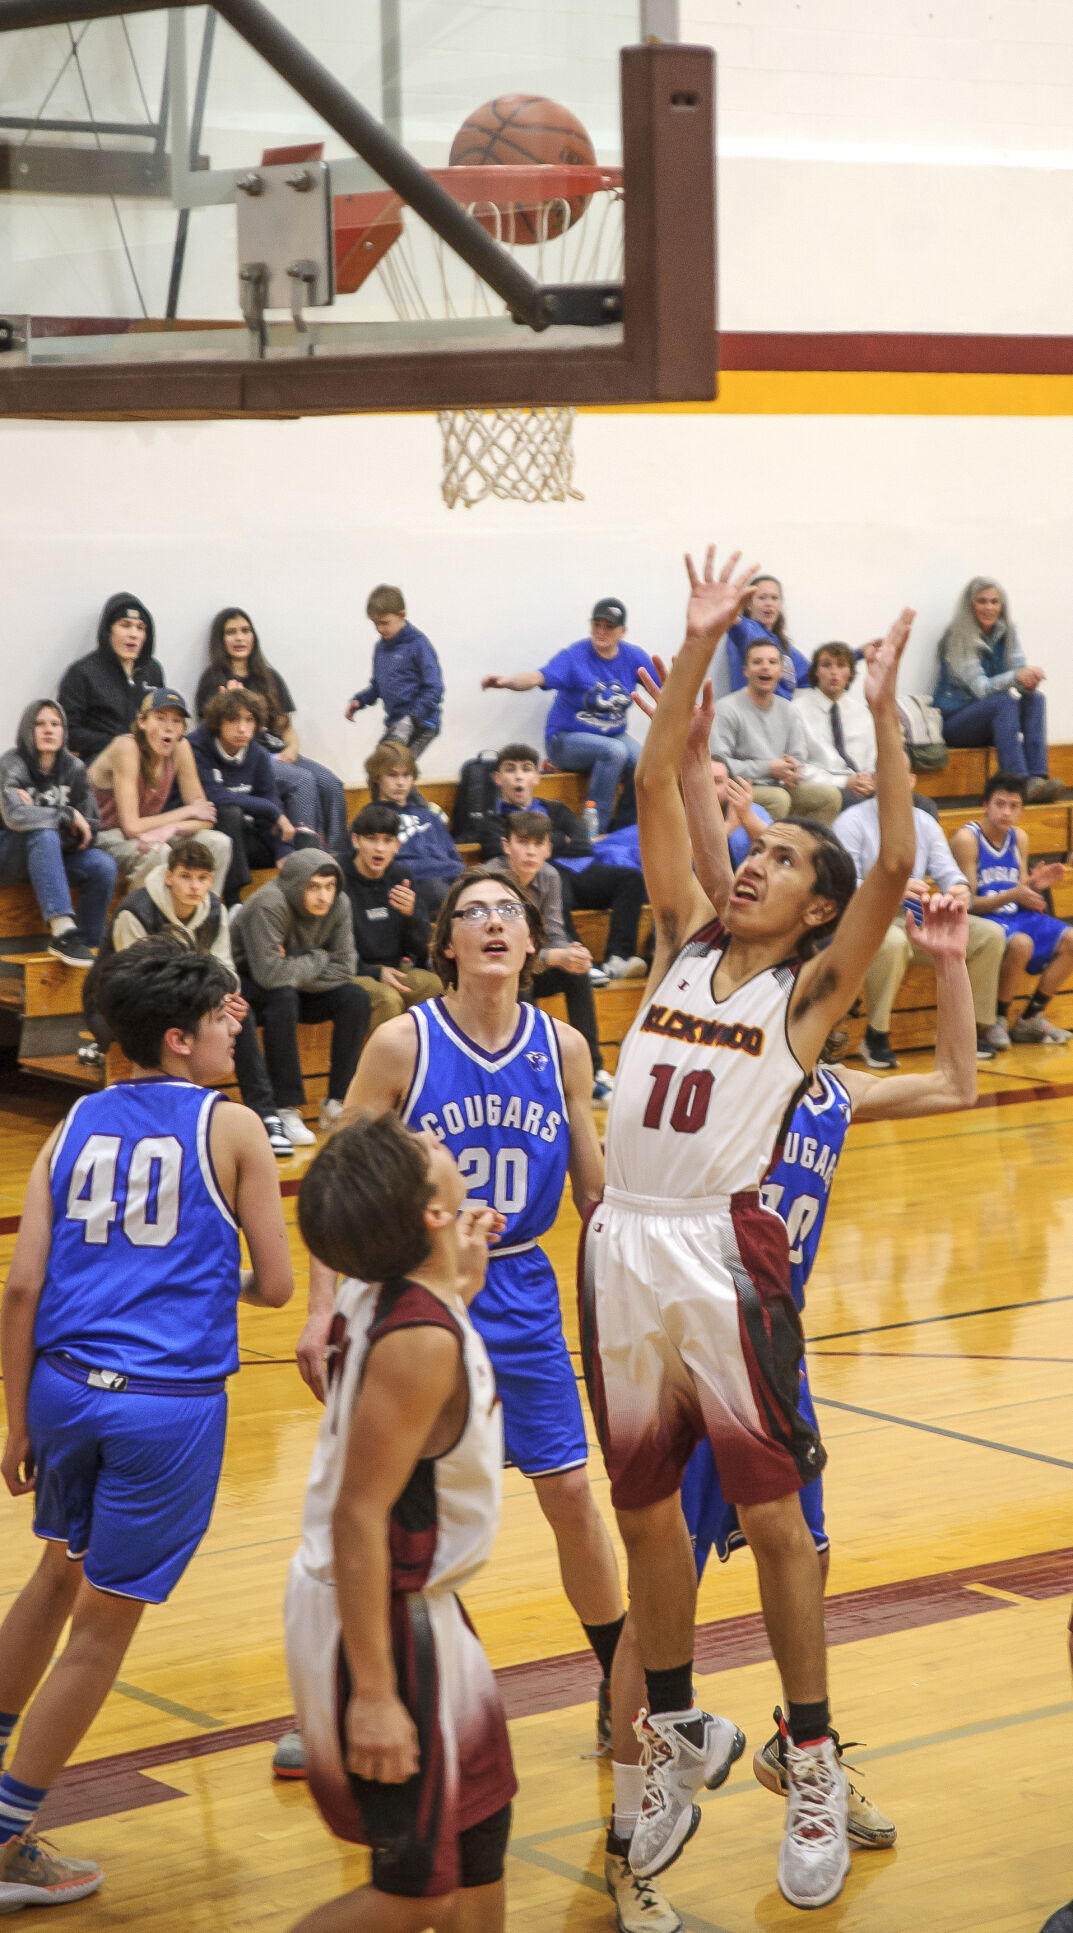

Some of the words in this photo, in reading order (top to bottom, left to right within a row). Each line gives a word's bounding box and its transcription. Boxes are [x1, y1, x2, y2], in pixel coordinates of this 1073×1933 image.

[420, 1094, 562, 1143] COUGARS
[642, 1063, 716, 1134] 10
[65, 1133, 184, 1248] 40
[457, 1146, 529, 1214] 20
